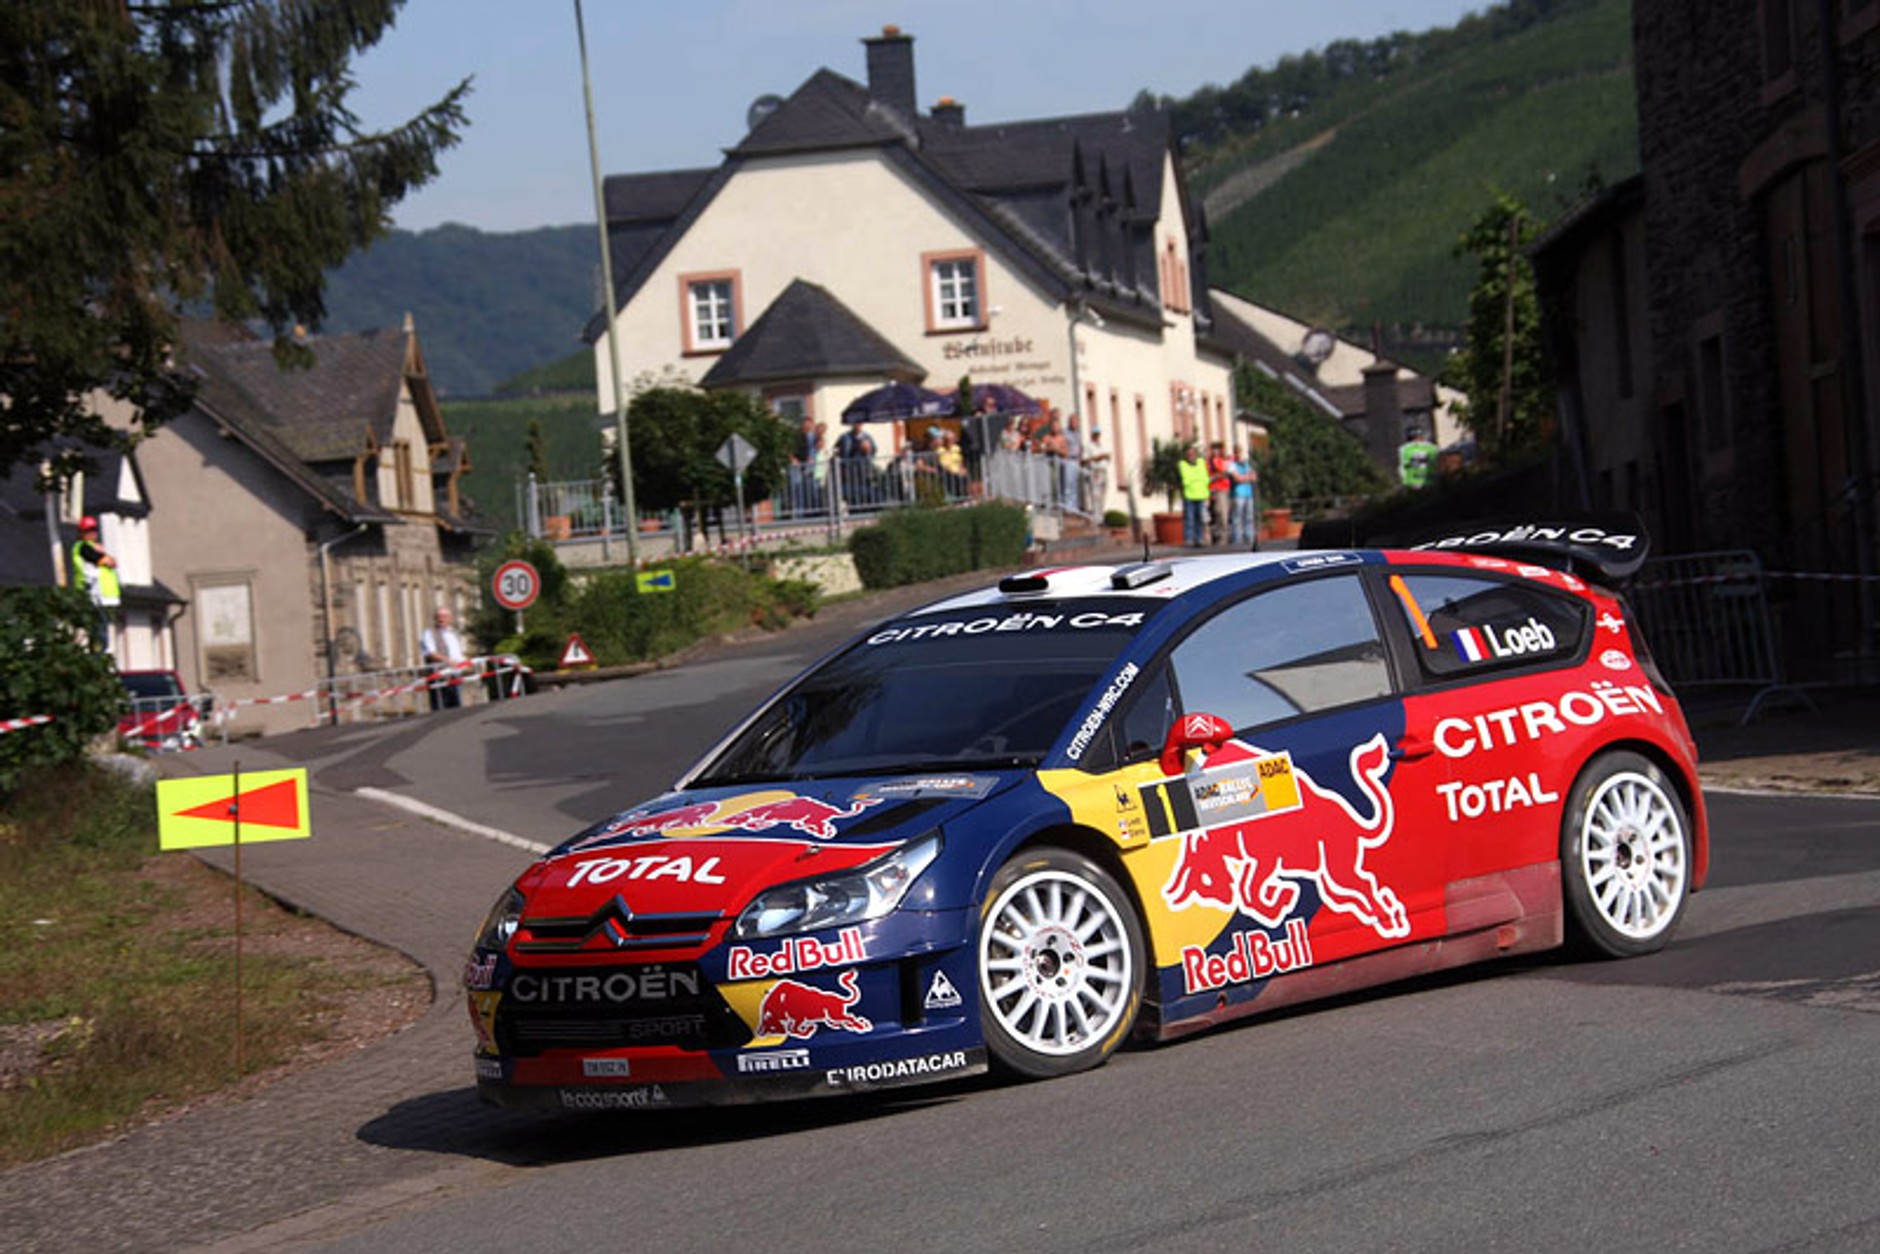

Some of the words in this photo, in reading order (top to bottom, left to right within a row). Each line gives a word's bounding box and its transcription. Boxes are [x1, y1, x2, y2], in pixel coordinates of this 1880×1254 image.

[1569, 528, 1637, 549] C4
[503, 574, 529, 596] 30
[867, 612, 1063, 645] CITROËN
[1069, 612, 1145, 628] C4
[1389, 574, 1438, 649] 1
[1483, 617, 1556, 657] Loeb
[1433, 680, 1664, 758] CITROËN
[1258, 758, 1290, 778] ADAC
[1156, 783, 1179, 835] 1
[566, 856, 727, 888] TOTAL
[728, 940, 799, 980] Red
[799, 929, 866, 970] Bull
[1183, 932, 1249, 994] Red
[1248, 918, 1313, 978] Bull
[511, 965, 700, 1001] CITROËN
[629, 1017, 706, 1039] SPORT
[737, 1049, 810, 1072] PIRELLI
